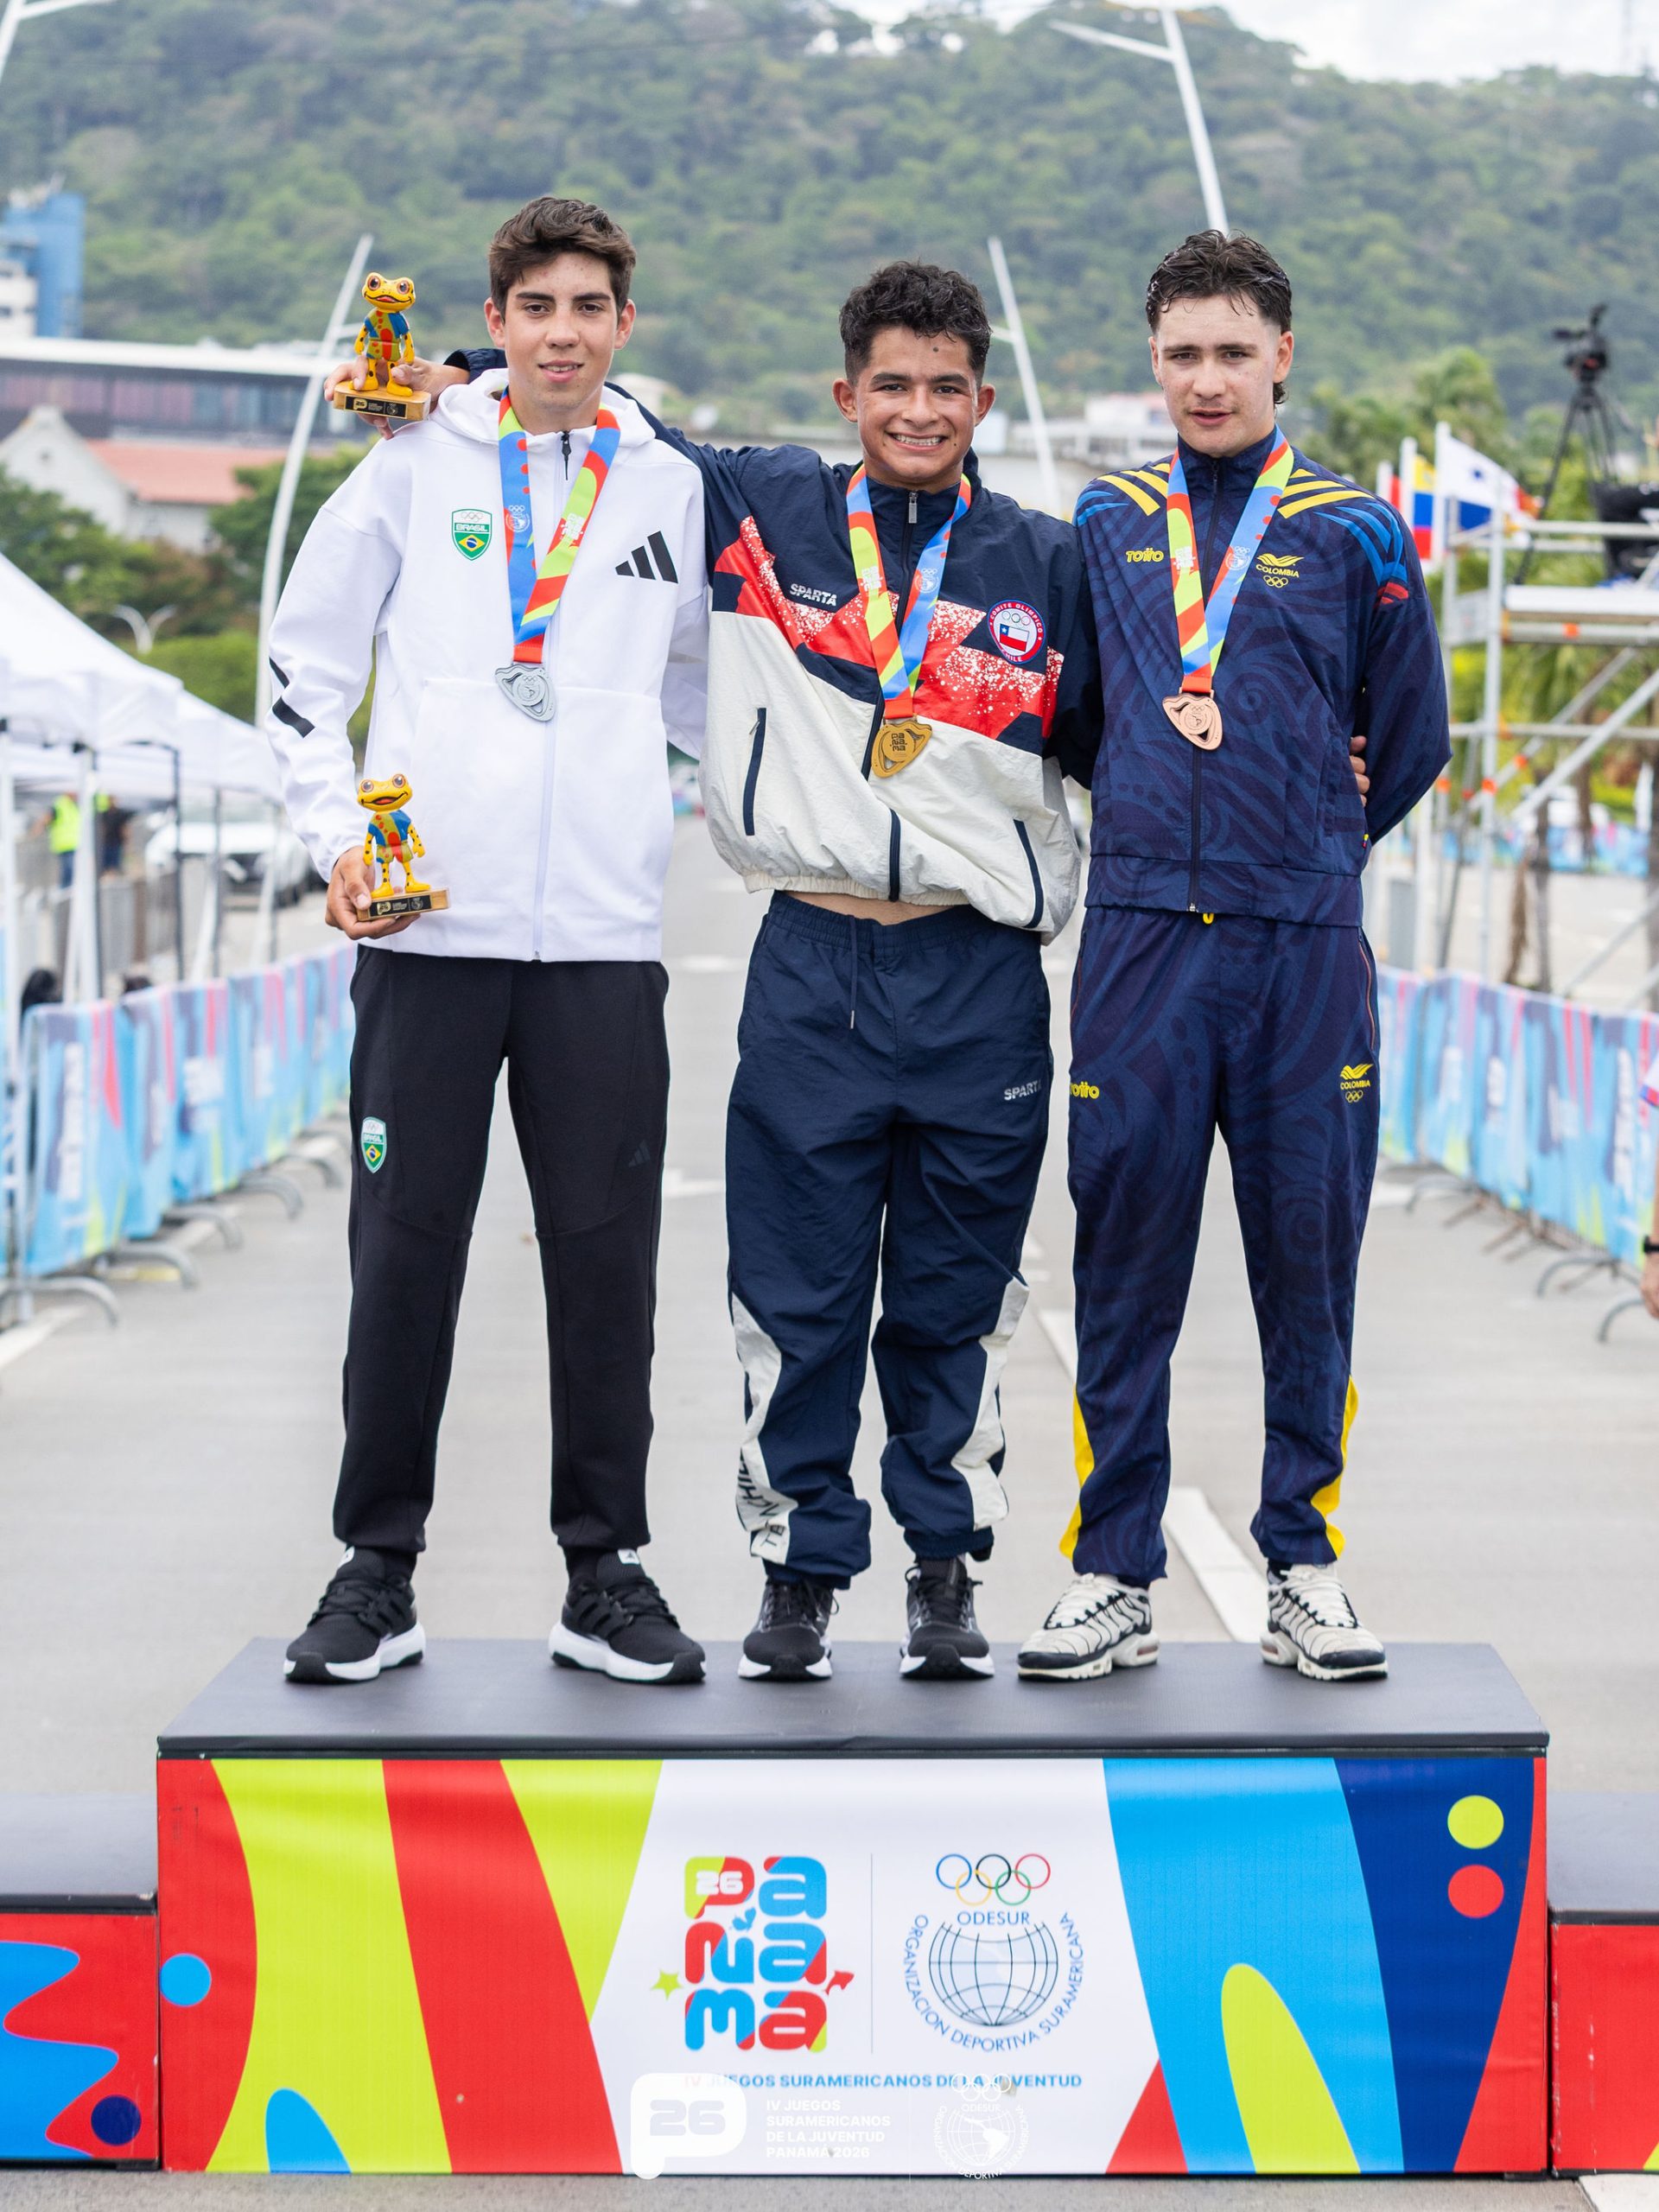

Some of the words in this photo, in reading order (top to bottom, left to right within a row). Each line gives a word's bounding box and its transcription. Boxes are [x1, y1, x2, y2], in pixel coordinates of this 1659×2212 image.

[1255, 563, 1300, 578] COLOMBIA
[789, 583, 837, 606] SPARTA
[1340, 1079, 1371, 1090] COLOMBIA
[696, 1871, 744, 1896] 26
[957, 1910, 1031, 1926] ODESUR
[904, 1914, 950, 2036] ORGANIZACION
[950, 2029, 1040, 2053] DEPORTIVA
[1039, 1911, 1084, 2035] SURAMERICANA
[779, 2074, 932, 2088] SURAMERICANOS
